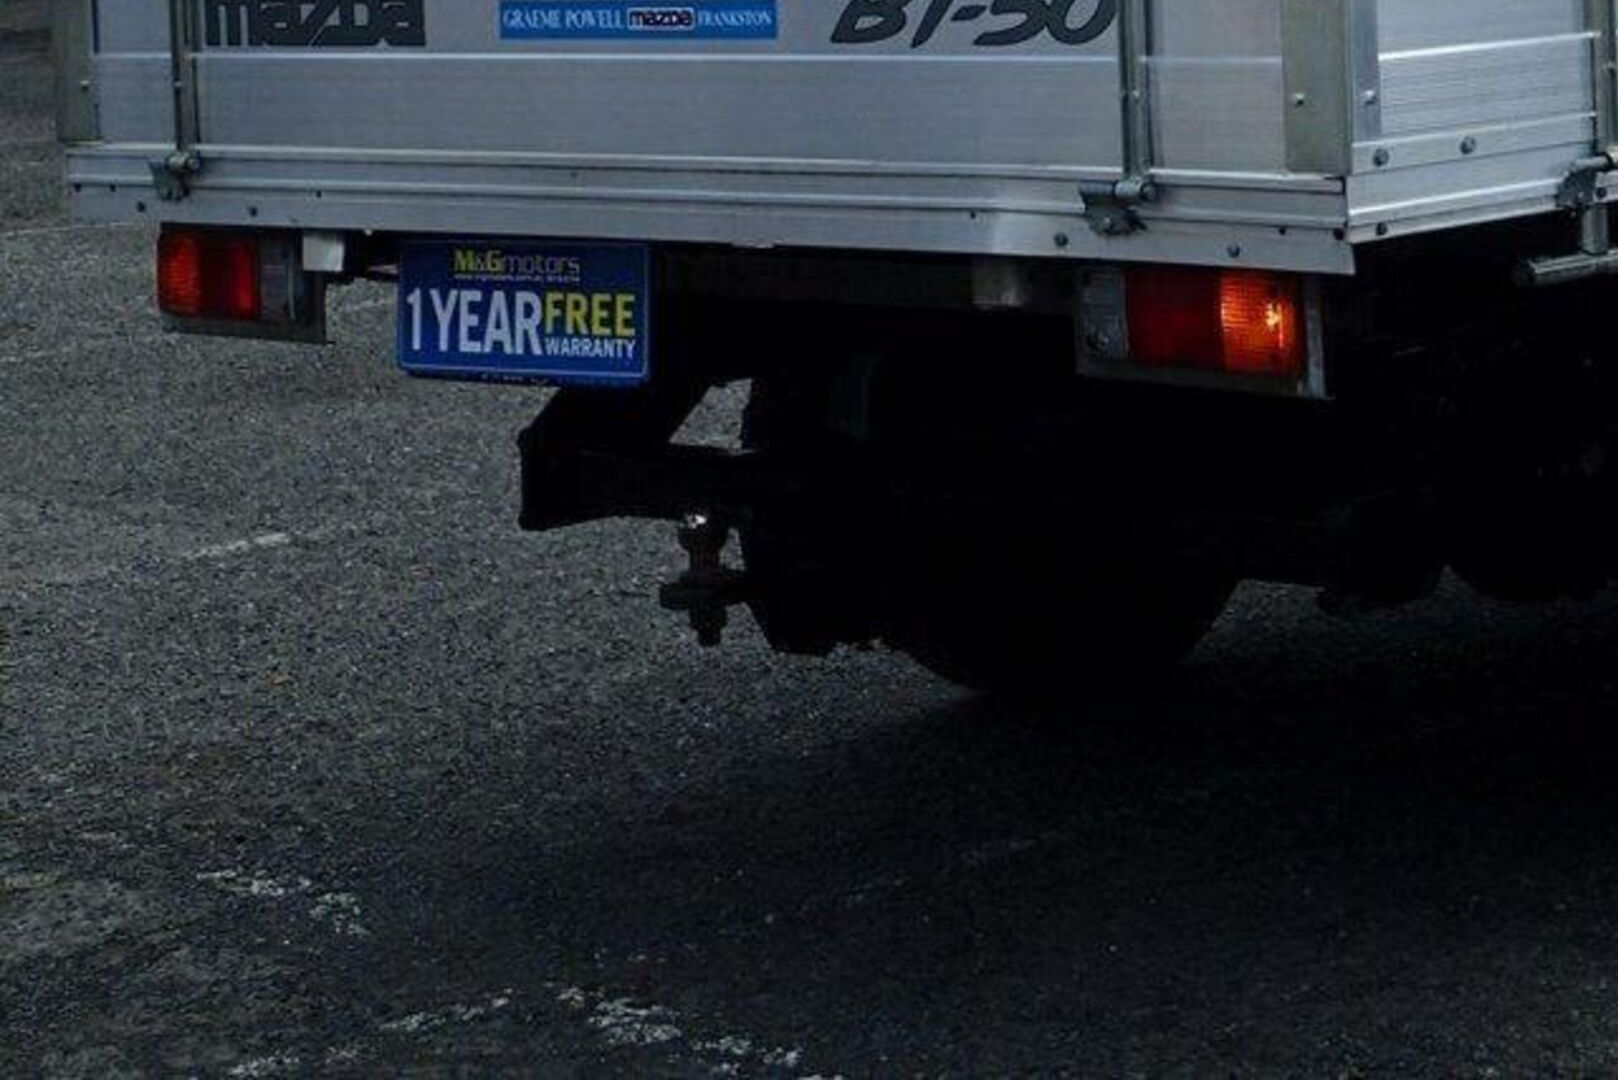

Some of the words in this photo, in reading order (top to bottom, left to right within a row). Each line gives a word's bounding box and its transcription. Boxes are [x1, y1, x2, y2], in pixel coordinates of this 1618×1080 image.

[566, 8, 624, 30] POWELL
[407, 287, 422, 351] 1
[430, 289, 543, 355] YEAR
[545, 292, 636, 337] FREE
[545, 337, 637, 359] WARRANTY
